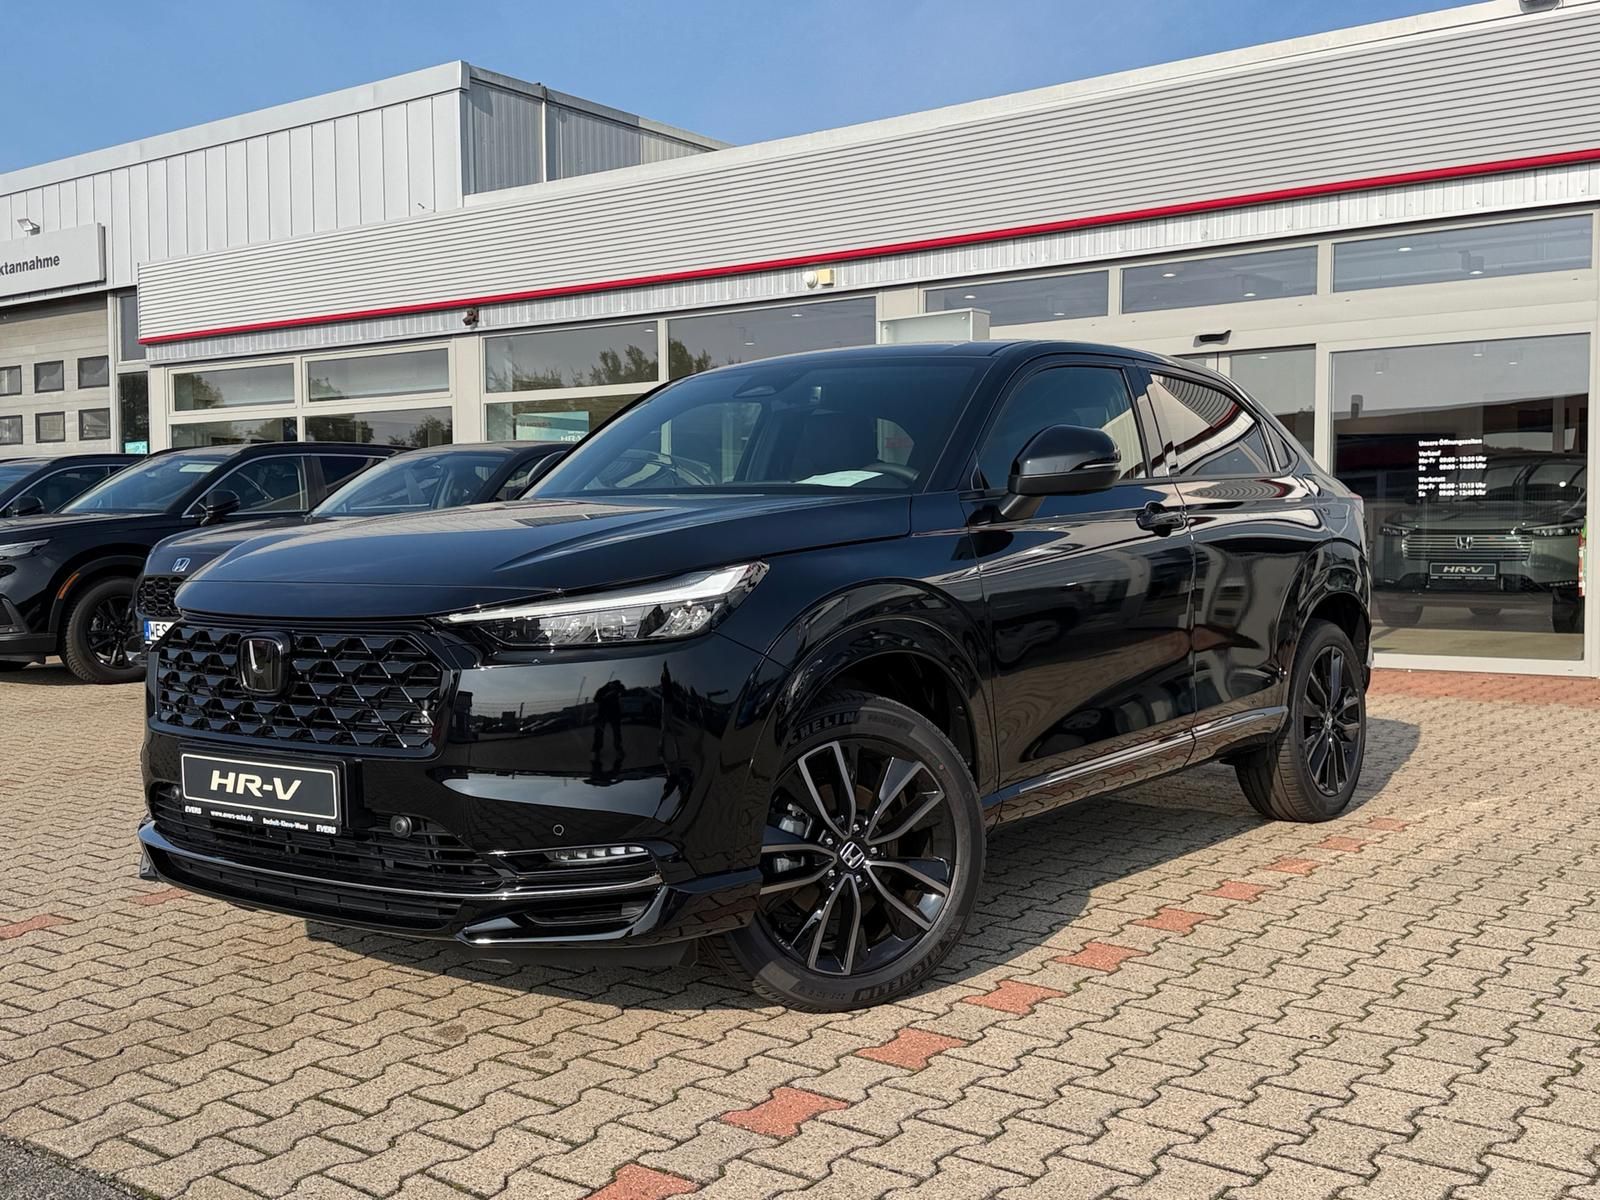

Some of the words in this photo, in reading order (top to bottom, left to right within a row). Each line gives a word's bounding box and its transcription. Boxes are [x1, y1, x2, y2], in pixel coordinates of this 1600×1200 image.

[1438, 438, 1483, 447] Öffnungszeiten
[1443, 565, 1483, 574] HR-V
[210, 769, 302, 801] HR-V
[184, 805, 202, 815] EVERS
[316, 824, 337, 835] EVERS
